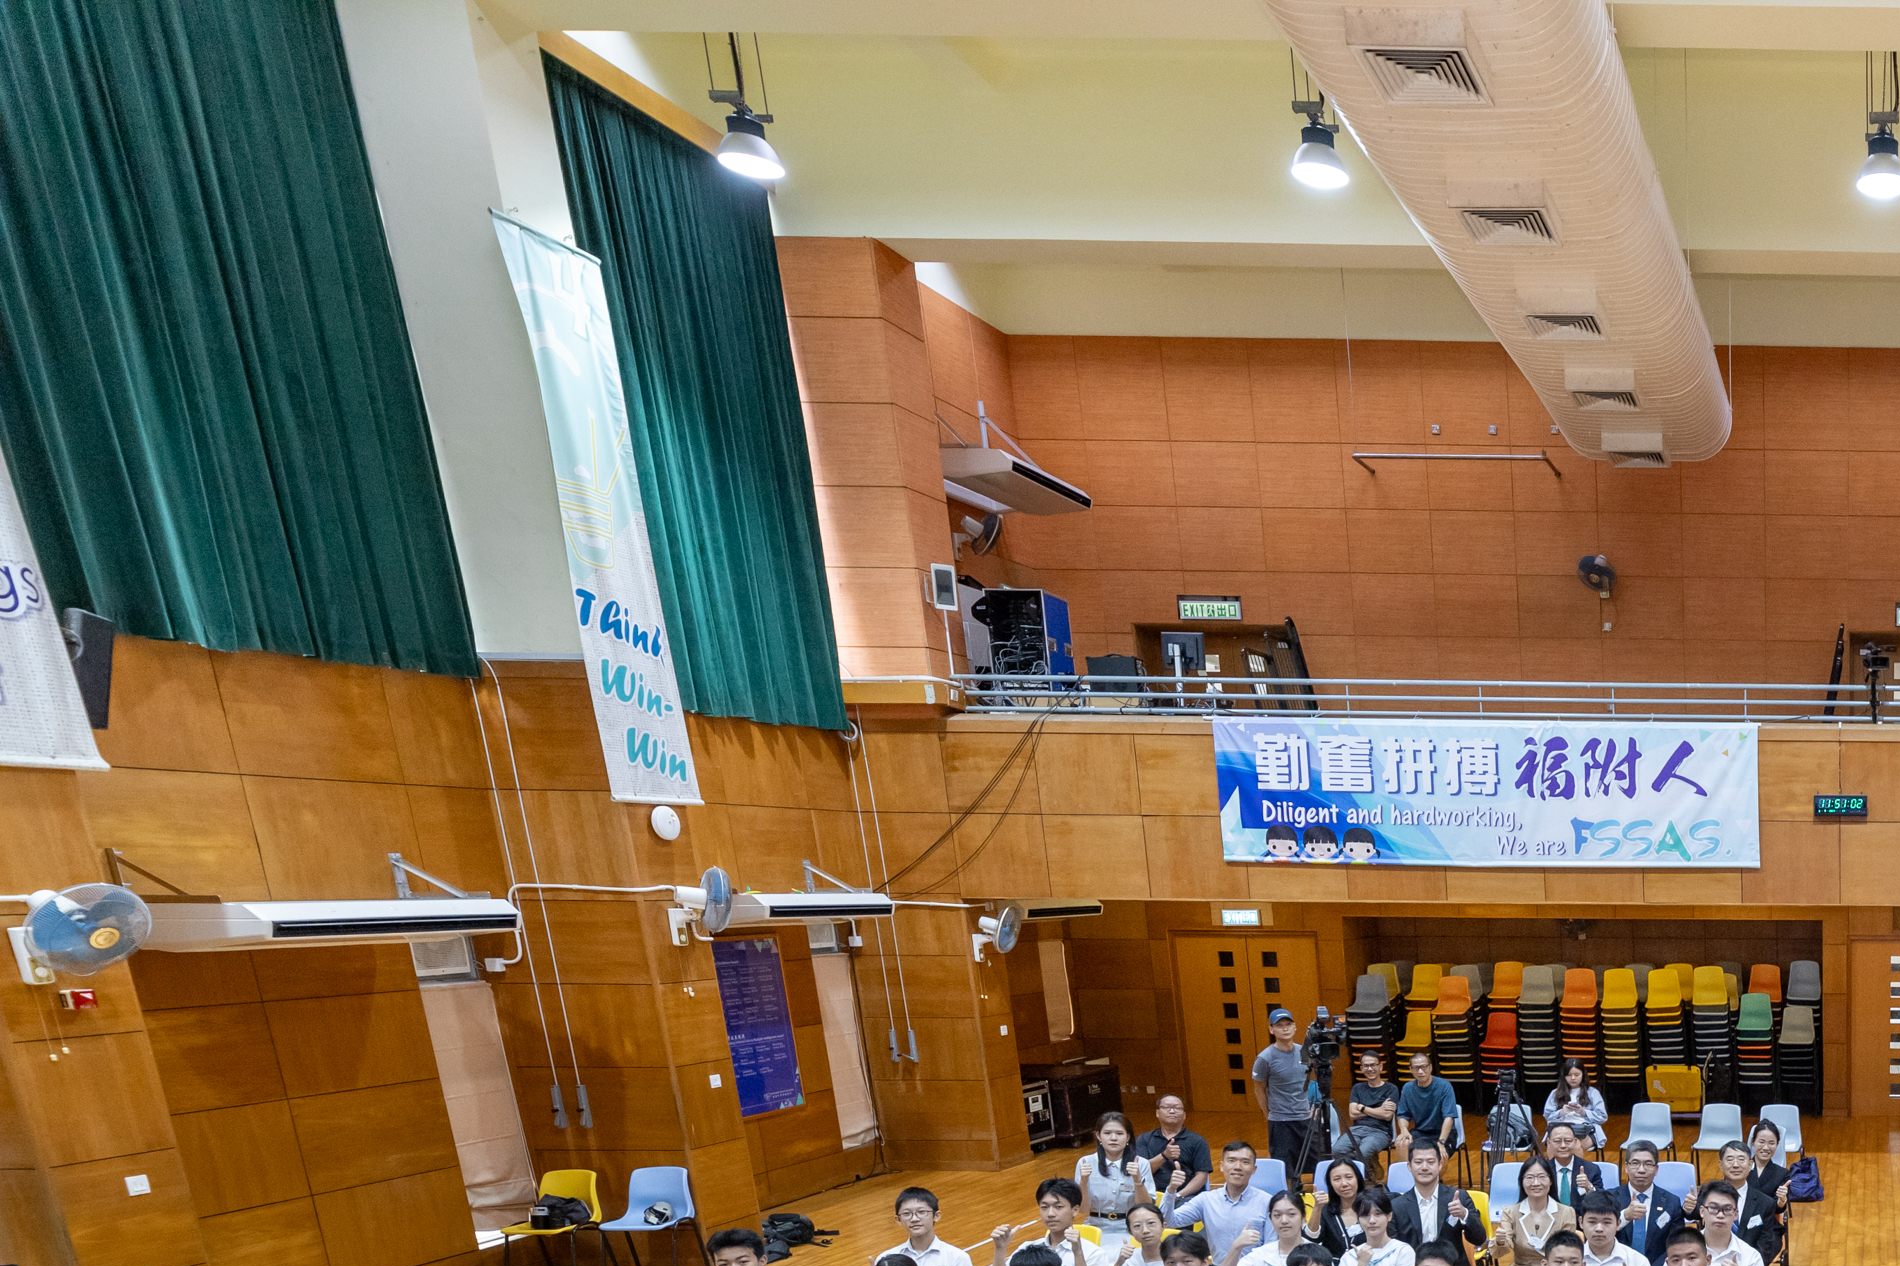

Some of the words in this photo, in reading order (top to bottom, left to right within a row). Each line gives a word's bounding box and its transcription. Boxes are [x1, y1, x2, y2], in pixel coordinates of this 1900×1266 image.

[1182, 603, 1204, 618] EXIT
[1217, 604, 1237, 618] 出口
[601, 658, 673, 718] Win-
[626, 727, 687, 783] Win
[1820, 798, 1863, 809] 11:51:02
[1261, 799, 1340, 828] Diligent
[1345, 803, 1383, 826] and
[1388, 804, 1524, 833] hardworking,
[1496, 834, 1525, 857] We
[1528, 838, 1567, 857] are
[1223, 911, 1241, 924] EXIT
